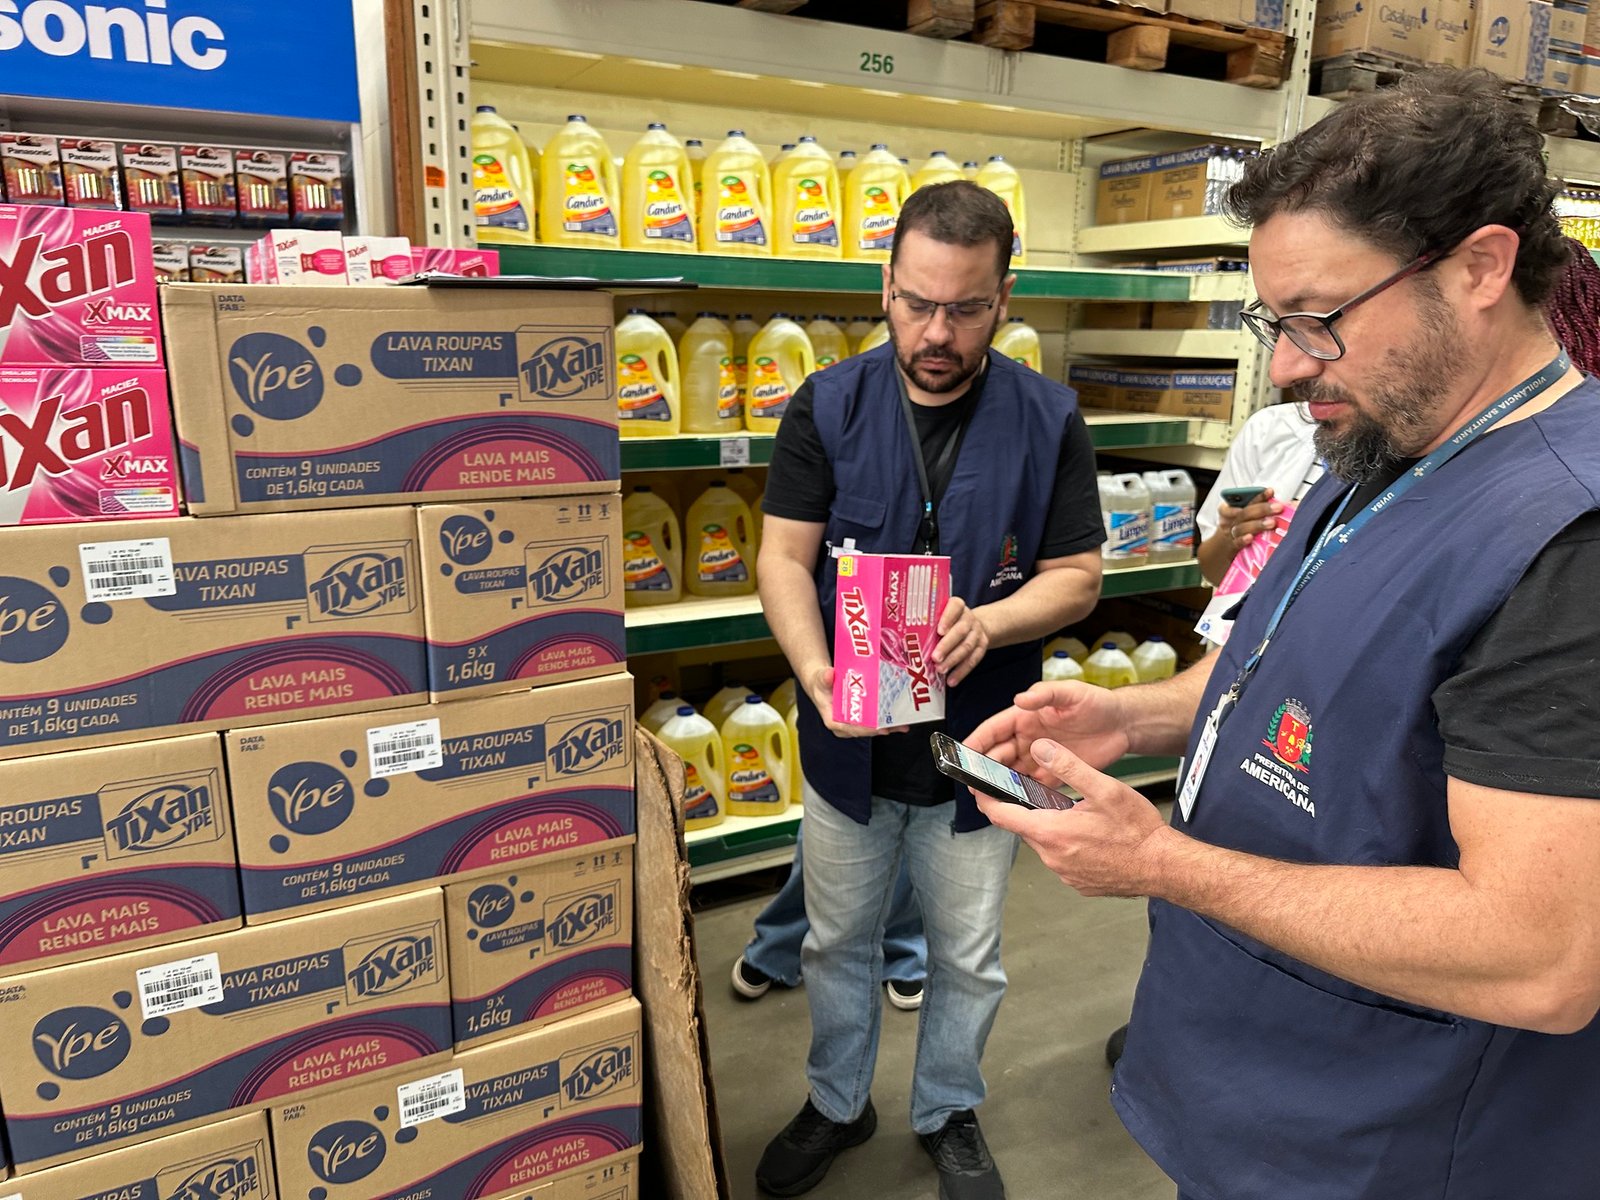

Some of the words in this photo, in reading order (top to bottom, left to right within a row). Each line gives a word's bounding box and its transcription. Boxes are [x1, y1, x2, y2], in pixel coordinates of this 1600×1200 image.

[860, 52, 894, 74] 256
[83, 220, 121, 237] MACIEZ
[218, 295, 245, 303] DATA
[388, 337, 433, 351] LAVA
[436, 336, 503, 350] ROUPAS
[423, 357, 473, 372] TIXAN
[101, 378, 139, 396] MACIEZ
[232, 352, 315, 404] Ypê
[1176, 376, 1196, 385] LAVA
[1197, 376, 1232, 388] LOUÇAS
[245, 464, 297, 479] CONTÉM
[301, 460, 312, 476] 9
[316, 461, 381, 475] UNIDADES
[464, 452, 506, 467] LAVA
[510, 450, 550, 464] MAIS
[459, 469, 512, 485] RENDE
[516, 467, 556, 481] MAIS
[266, 483, 284, 495] DE
[286, 479, 328, 496] 1,6kg
[329, 479, 365, 491] CADA
[1371, 492, 1395, 512] UVISA
[174, 566, 210, 582] AVA
[214, 559, 289, 579] ROUPAS
[462, 572, 484, 582] LAVA
[486, 568, 520, 578] ROUPAS
[199, 583, 257, 602] TIXAN
[479, 580, 505, 590] TIXAN
[468, 647, 475, 659] 9
[537, 660, 569, 672] RENDE
[572, 656, 596, 666] MAIS
[541, 650, 566, 662] LAVA
[568, 646, 593, 656] MAIS
[249, 672, 296, 691] LAVA
[301, 668, 346, 684] MAIS
[446, 660, 495, 685] 1,6kg
[47, 699, 59, 714] 9
[64, 694, 138, 712] UNIDADES
[244, 688, 305, 710] RENDE
[310, 684, 354, 702] MAIS
[9, 724, 28, 737] DE
[31, 717, 78, 734] 1,6kg
[80, 713, 120, 728] CADA
[240, 736, 265, 745] DATA
[441, 742, 470, 756] AVA
[473, 729, 533, 751] ROUPAS
[460, 752, 506, 771] TIXAN
[1240, 758, 1315, 818] AMERICANA
[1296, 782, 1310, 795] DE
[0, 800, 82, 827] ROUPAS
[495, 825, 533, 844] LAVA
[537, 818, 573, 834] MAIS
[490, 841, 538, 860] RENDE
[542, 832, 578, 849] MAIS
[282, 870, 329, 887] CONTÉM
[333, 863, 343, 877] 9
[346, 853, 406, 873] UNIDADES
[301, 887, 317, 898] DE
[319, 877, 357, 895] 1,6kg
[358, 871, 390, 887] CADA
[42, 912, 96, 934] LAVA
[101, 901, 150, 919] MAIS
[39, 927, 106, 953] RENDE
[110, 917, 160, 938] MAIS
[486, 930, 506, 942] LAVA
[507, 921, 538, 936] ROUPAS
[502, 934, 525, 946] TIXAN
[223, 974, 258, 991] AVA
[262, 954, 330, 982] ROUPAS
[248, 978, 300, 1002] TIXAN
[553, 995, 583, 1010] RENDE
[585, 988, 607, 1000] MAIS
[556, 988, 579, 1000] LAVA
[582, 980, 604, 991] MAIS
[487, 998, 494, 1009] 9
[467, 1009, 511, 1032] 1,6kg
[35, 1021, 120, 1071] Ypê
[293, 1051, 336, 1073] LAVA
[340, 1040, 380, 1059] MAIS
[289, 1063, 343, 1088] RENDE
[347, 1052, 387, 1073] MAIS
[465, 1087, 490, 1101] AVA
[493, 1065, 549, 1093] ROUPAS
[110, 1104, 121, 1119] 9
[125, 1089, 192, 1115] UNIDADES
[283, 1104, 306, 1115] DATA
[482, 1088, 524, 1111] TIXAN
[75, 1131, 94, 1143] DE
[95, 1118, 138, 1138] 1,6kg
[140, 1108, 176, 1126] CADA
[514, 1150, 549, 1170] LAVA
[552, 1138, 586, 1156] MAIS
[510, 1163, 554, 1184] RENDE
[557, 1149, 591, 1169] MAIS
